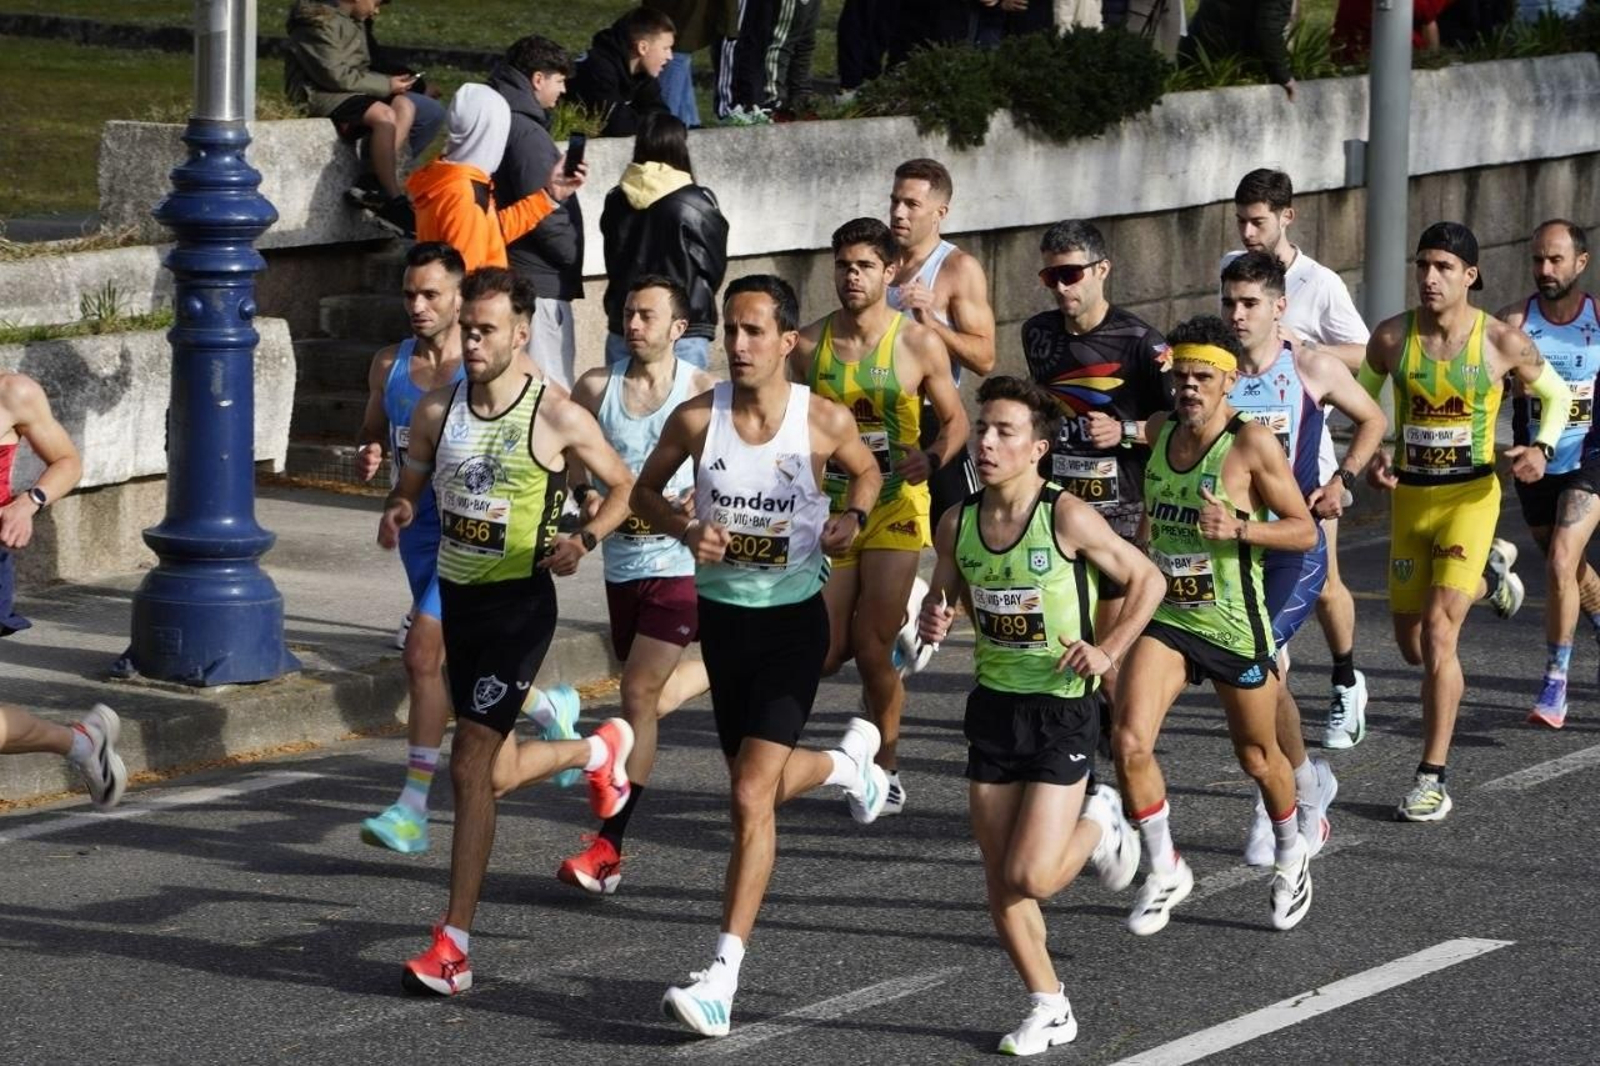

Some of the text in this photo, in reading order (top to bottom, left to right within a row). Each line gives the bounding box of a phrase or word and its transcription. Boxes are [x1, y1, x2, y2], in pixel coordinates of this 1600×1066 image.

[1422, 448, 1457, 464] 424
[1068, 480, 1102, 496] 476
[455, 517, 490, 542] 456
[729, 534, 771, 558] 602
[1168, 577, 1199, 597] 43
[989, 614, 1028, 636] 789
